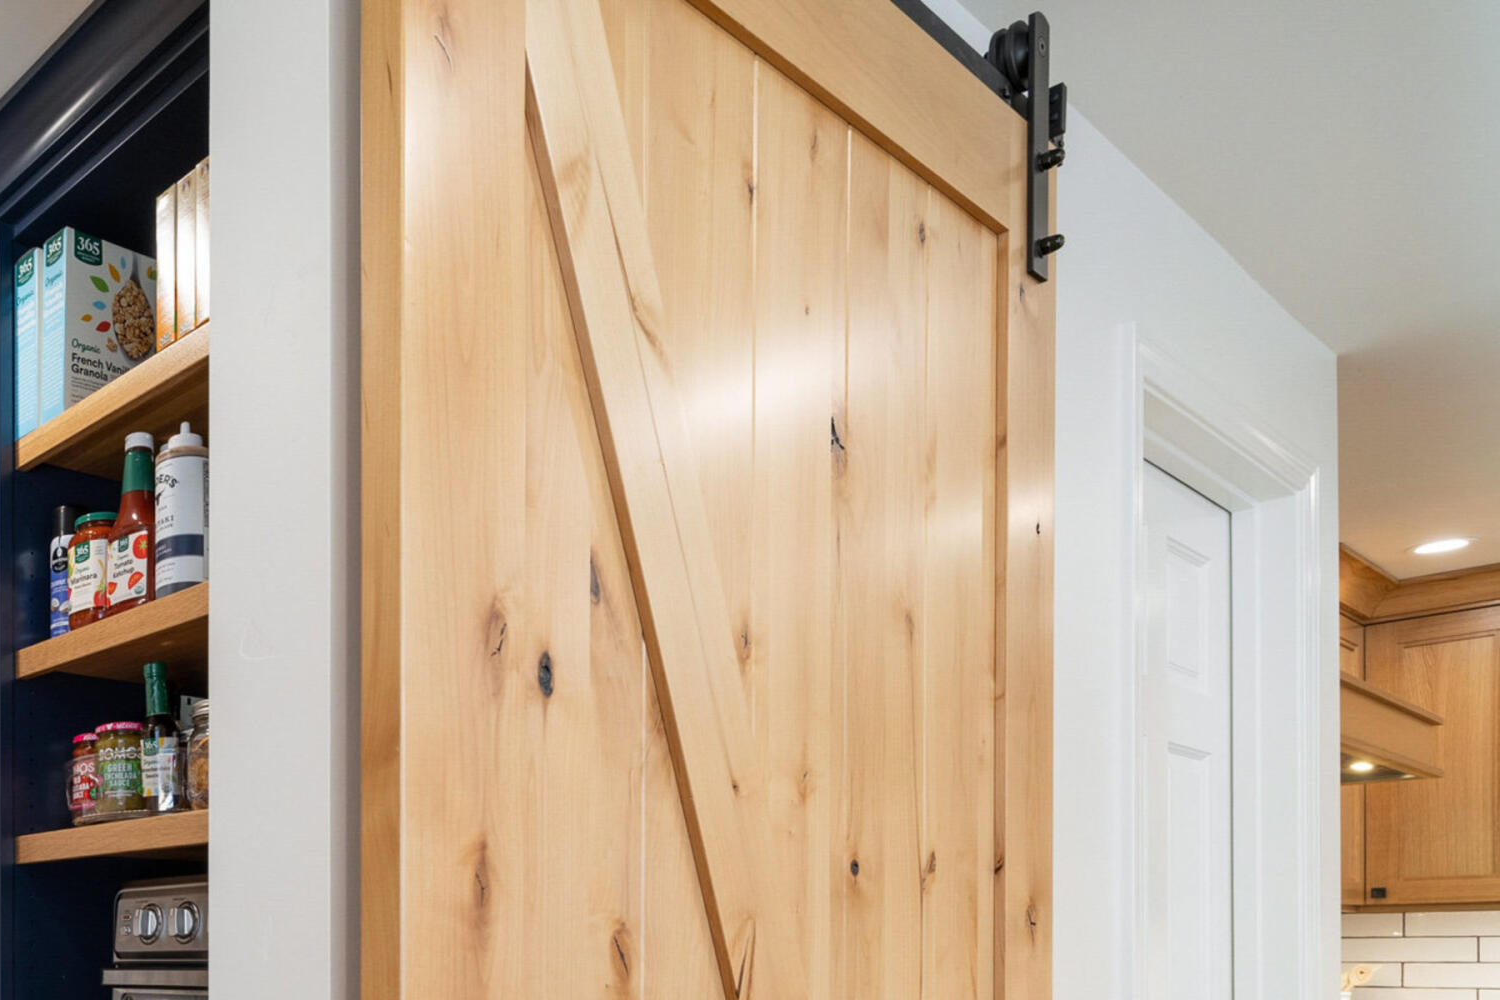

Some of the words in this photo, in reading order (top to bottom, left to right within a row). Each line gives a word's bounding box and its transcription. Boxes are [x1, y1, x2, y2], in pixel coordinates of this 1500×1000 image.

[77, 236, 100, 256] 365
[71, 338, 101, 354] Organic
[71, 352, 104, 370] French
[71, 364, 108, 381] Granola
[113, 559, 134, 570] Tomato
[112, 567, 135, 579] Ketchup
